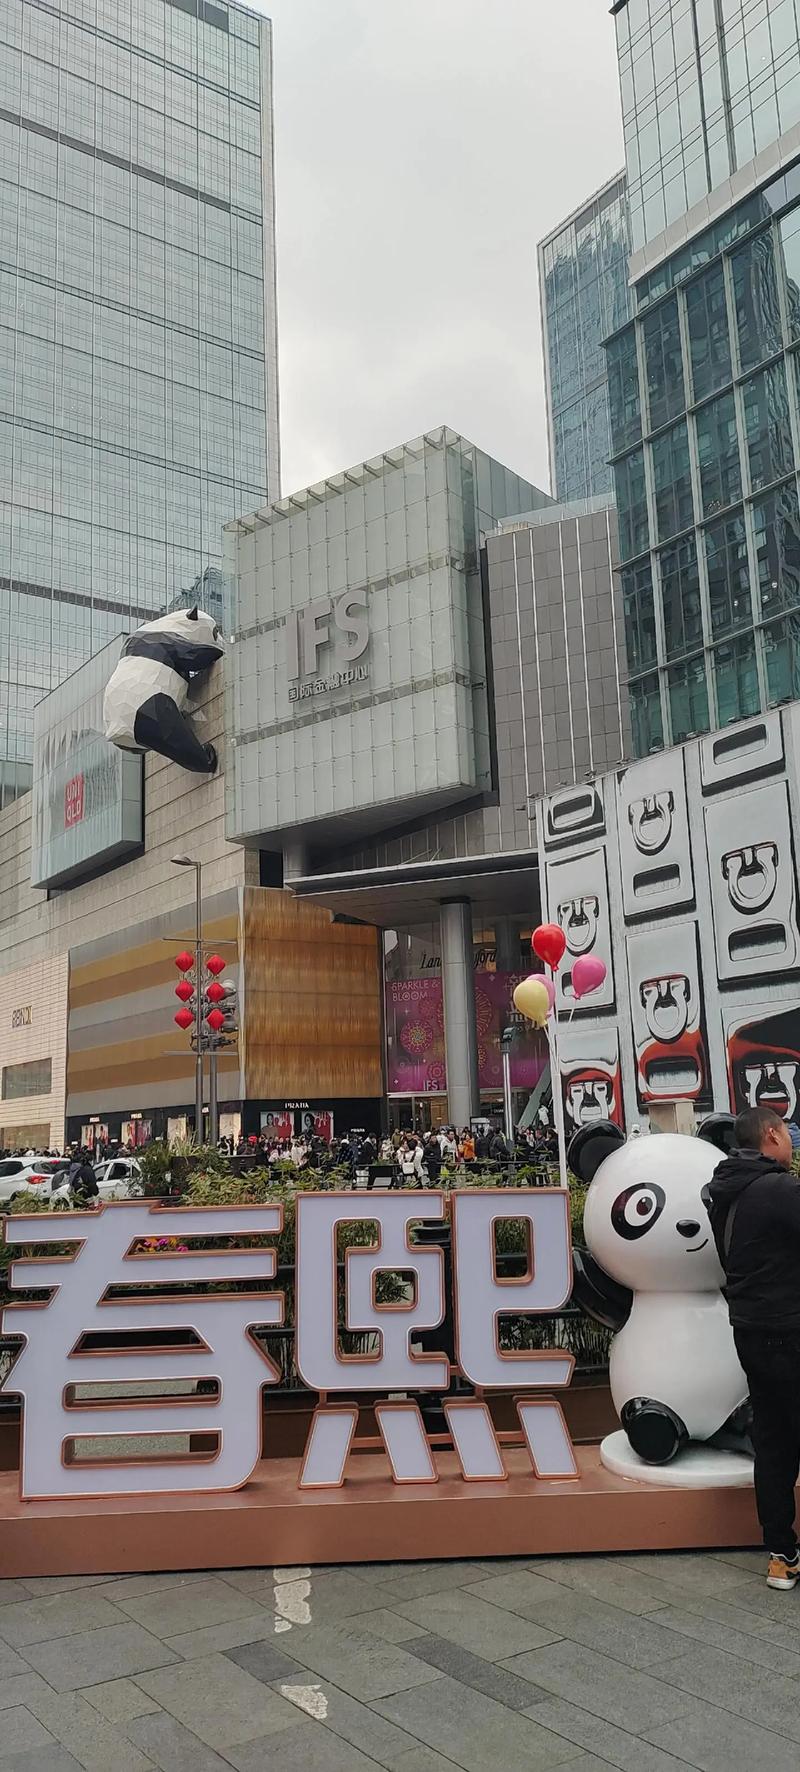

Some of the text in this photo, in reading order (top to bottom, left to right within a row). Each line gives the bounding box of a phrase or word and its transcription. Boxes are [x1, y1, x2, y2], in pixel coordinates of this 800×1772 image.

[285, 590, 370, 682] IFS
[288, 664, 370, 703] 国际金融中心
[66, 779, 81, 802] UNI
[66, 799, 81, 821] QLO
[419, 954, 442, 970] Lan
[391, 980, 430, 992] SPARKLE
[392, 991, 428, 1002] BLOOM
[423, 1080, 439, 1091] IFS
[0, 1189, 581, 1502] 春熙
